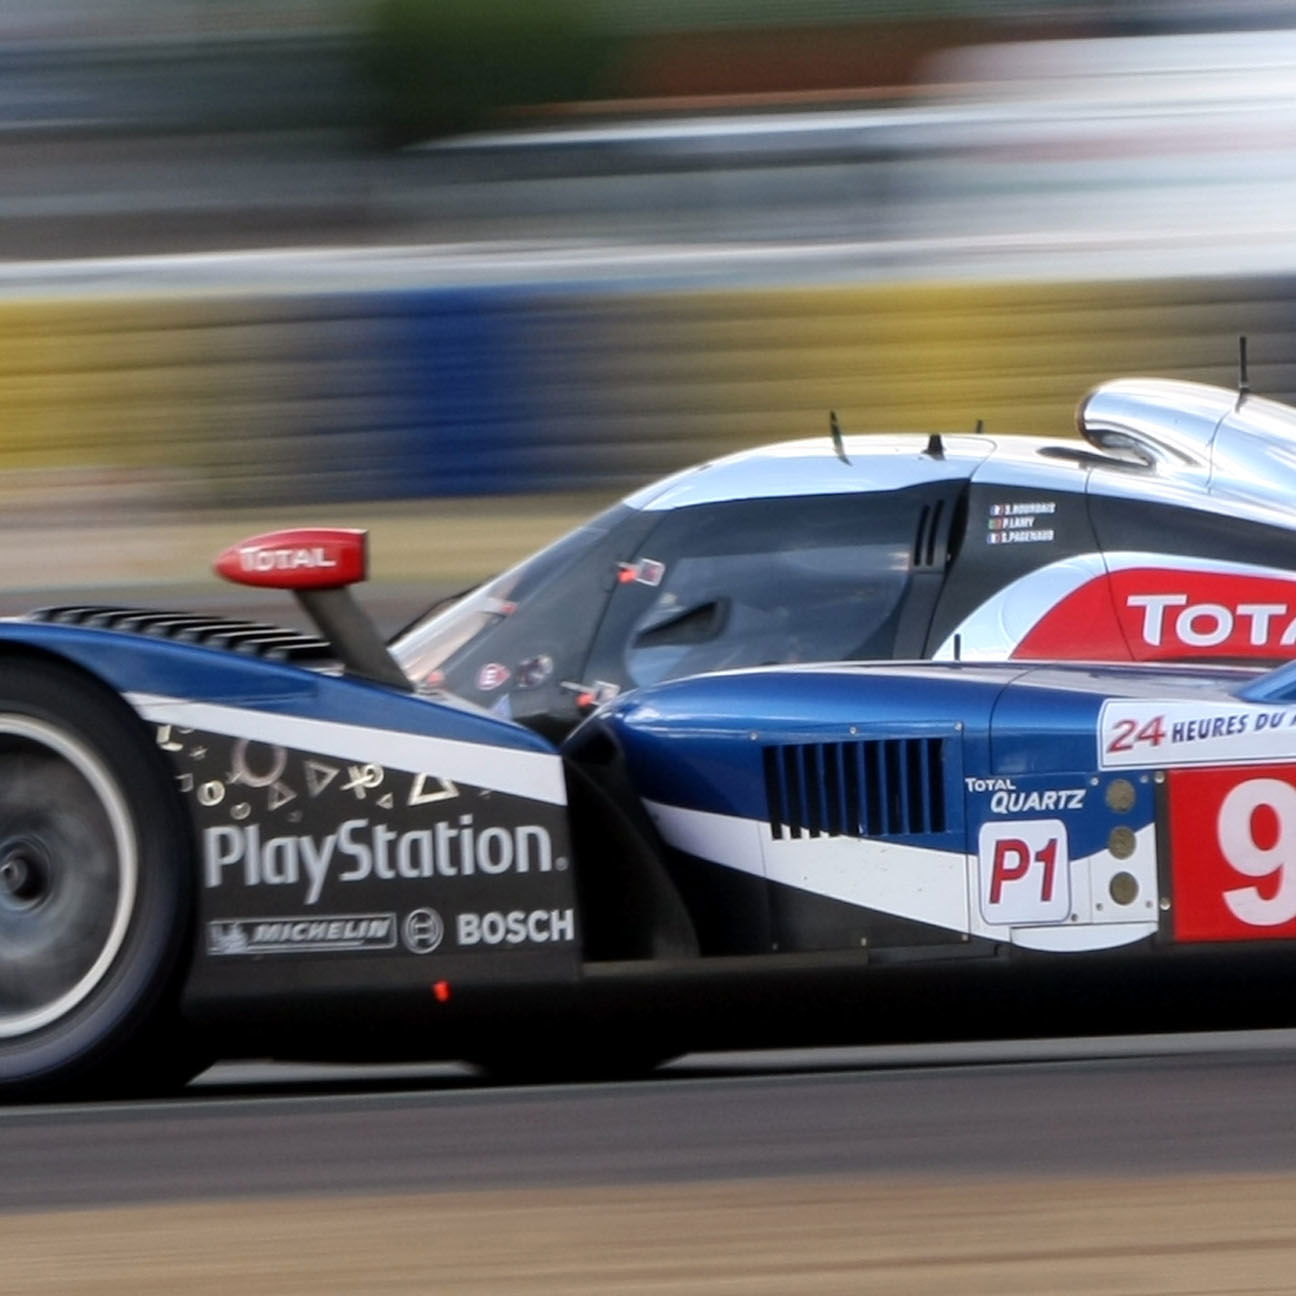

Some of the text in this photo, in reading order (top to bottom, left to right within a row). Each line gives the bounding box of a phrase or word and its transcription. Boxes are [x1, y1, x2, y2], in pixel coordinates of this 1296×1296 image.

[239, 546, 337, 572] TOTAL
[1106, 714, 1167, 754] 24
[1171, 714, 1249, 744] HEURES
[1254, 712, 1286, 732] DU
[964, 777, 1017, 793] TOTAL
[990, 789, 1087, 814] QUARTZ
[204, 814, 553, 904] PlayStation
[989, 837, 1059, 905] P1
[253, 918, 391, 943] MICHELIN
[456, 909, 575, 945] BOSCH
